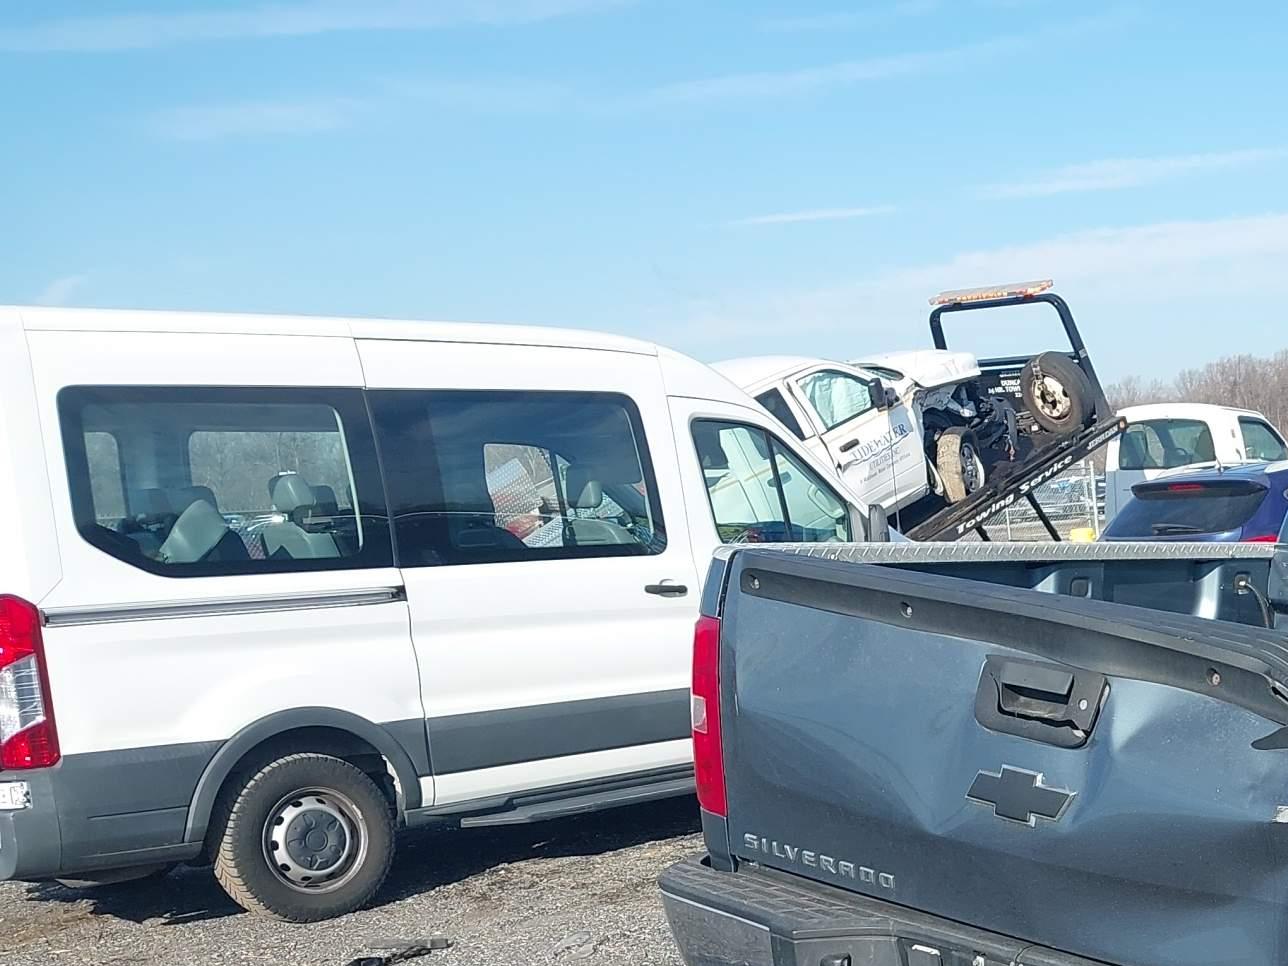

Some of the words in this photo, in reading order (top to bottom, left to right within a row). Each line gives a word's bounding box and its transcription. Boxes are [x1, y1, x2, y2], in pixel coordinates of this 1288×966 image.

[956, 493, 1014, 534] Towing
[1018, 455, 1073, 494] Service
[744, 832, 896, 889] SILVERADO
